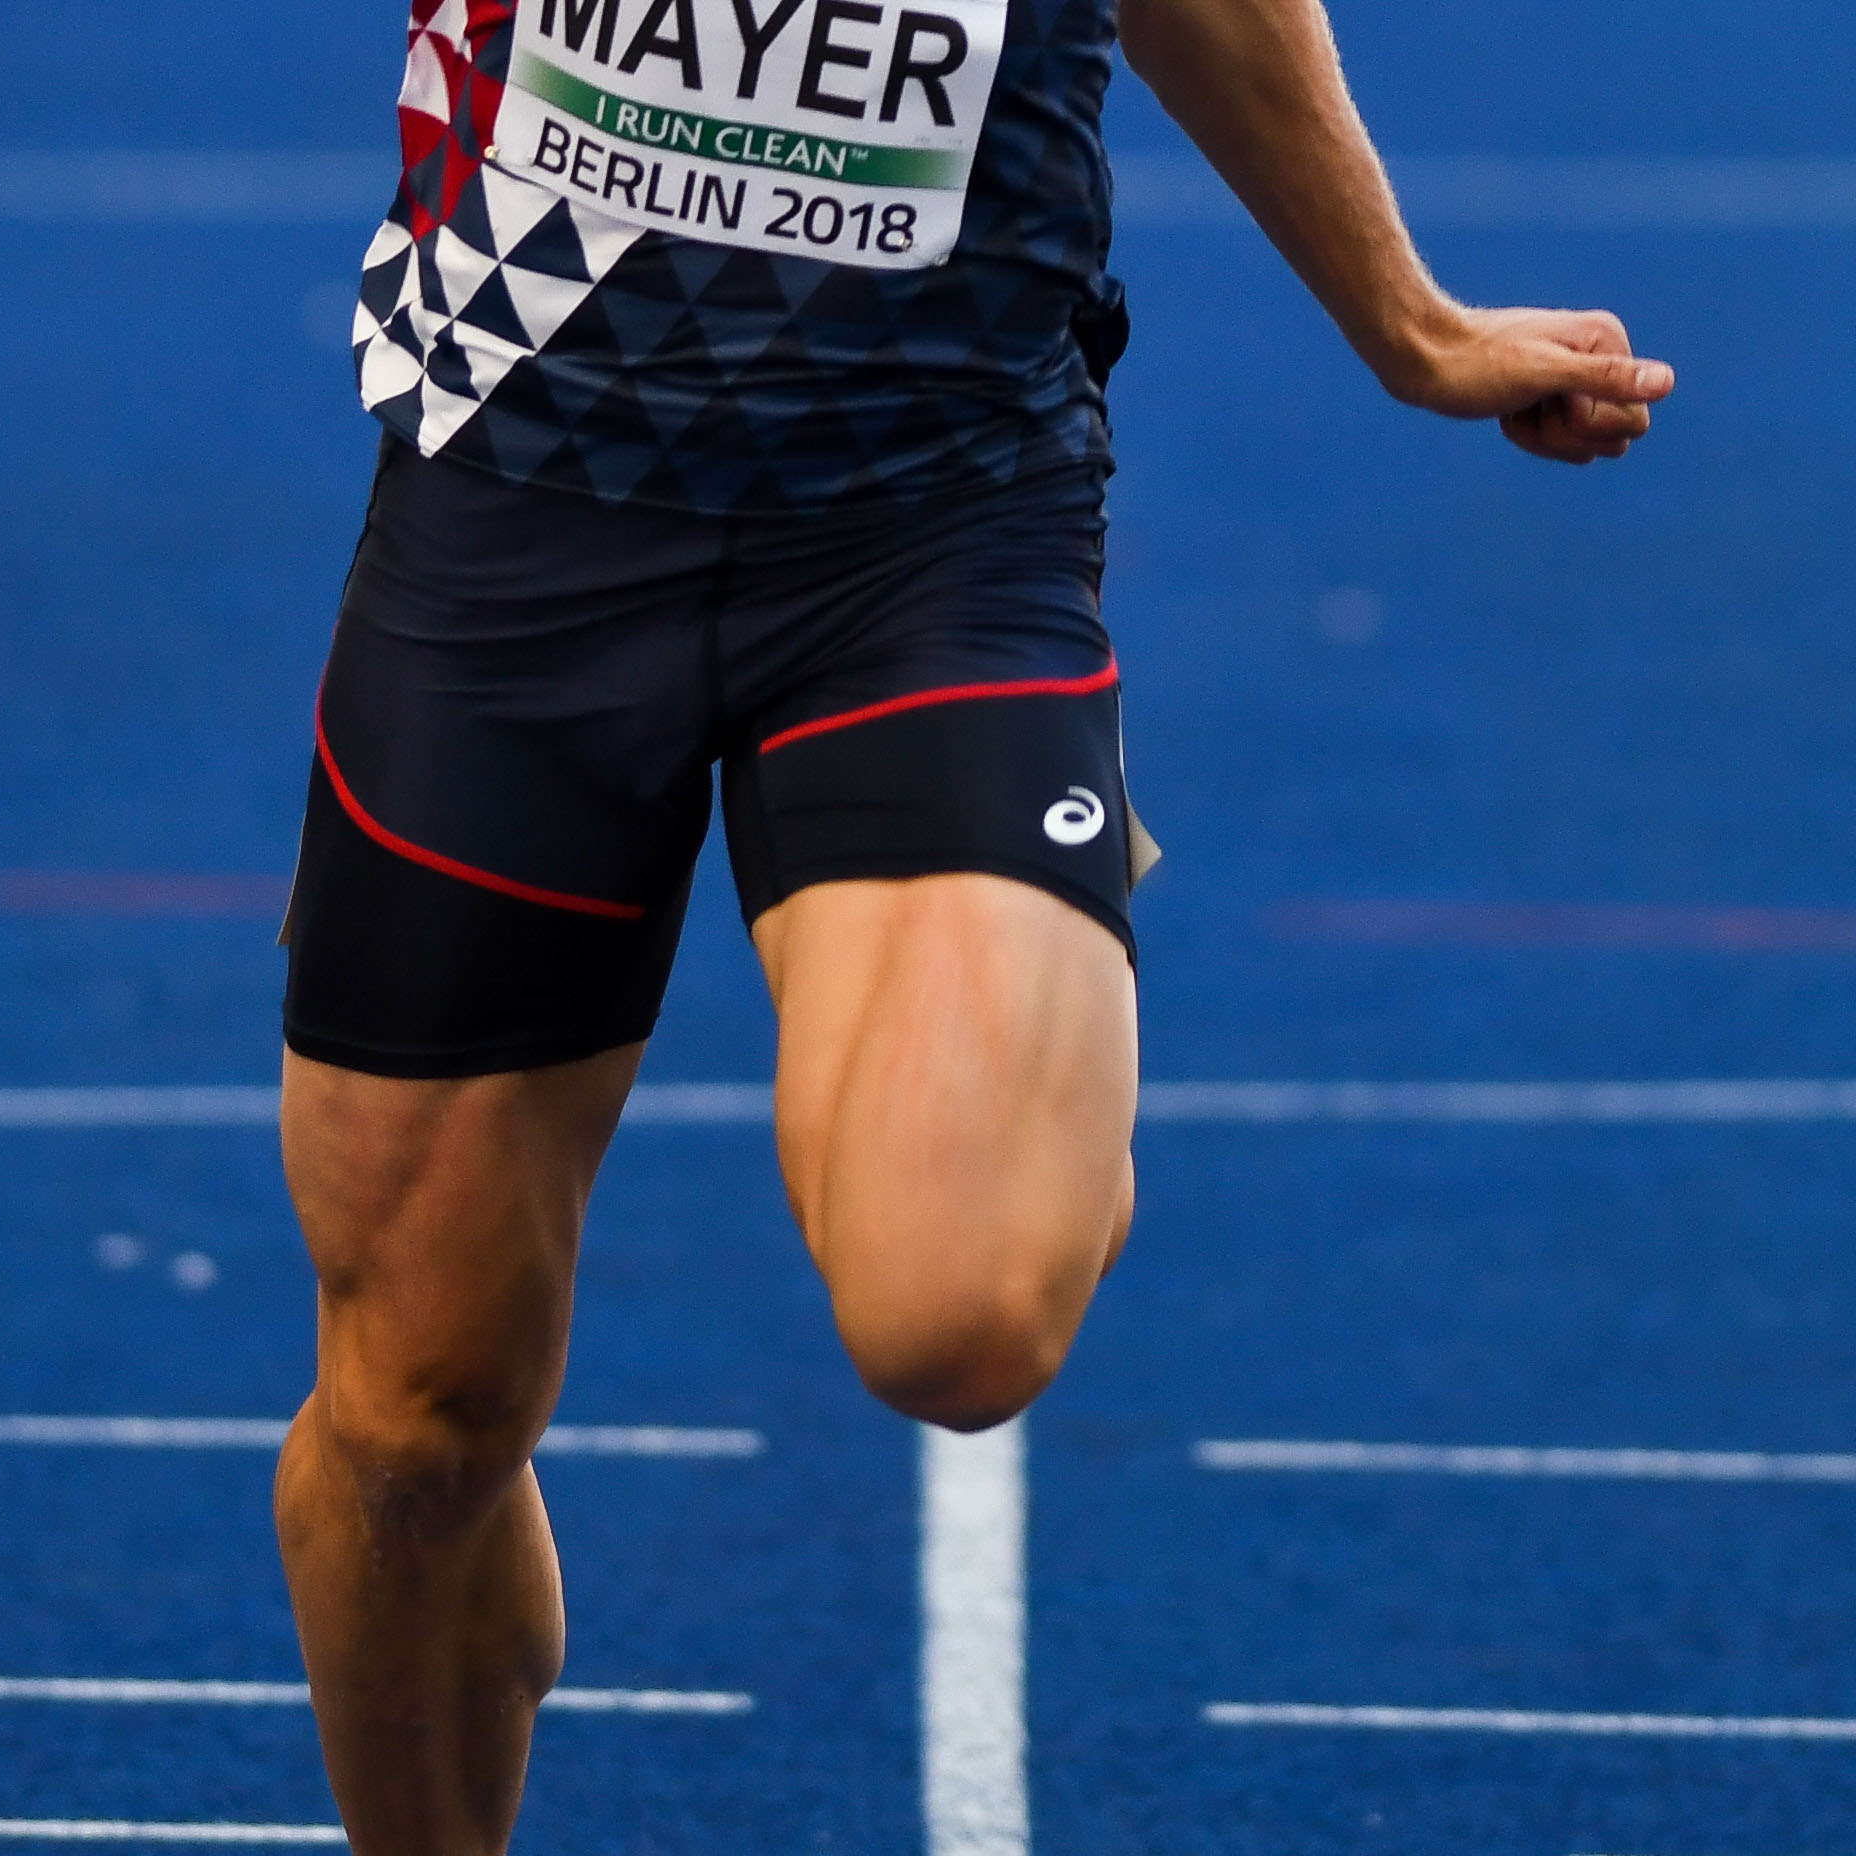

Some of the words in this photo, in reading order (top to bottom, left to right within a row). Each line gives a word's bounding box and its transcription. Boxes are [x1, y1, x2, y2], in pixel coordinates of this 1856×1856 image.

[595, 95, 610, 124] I
[617, 103, 705, 148] RUN
[531, 117, 749, 230] BERLIN
[763, 187, 919, 255] 2018
